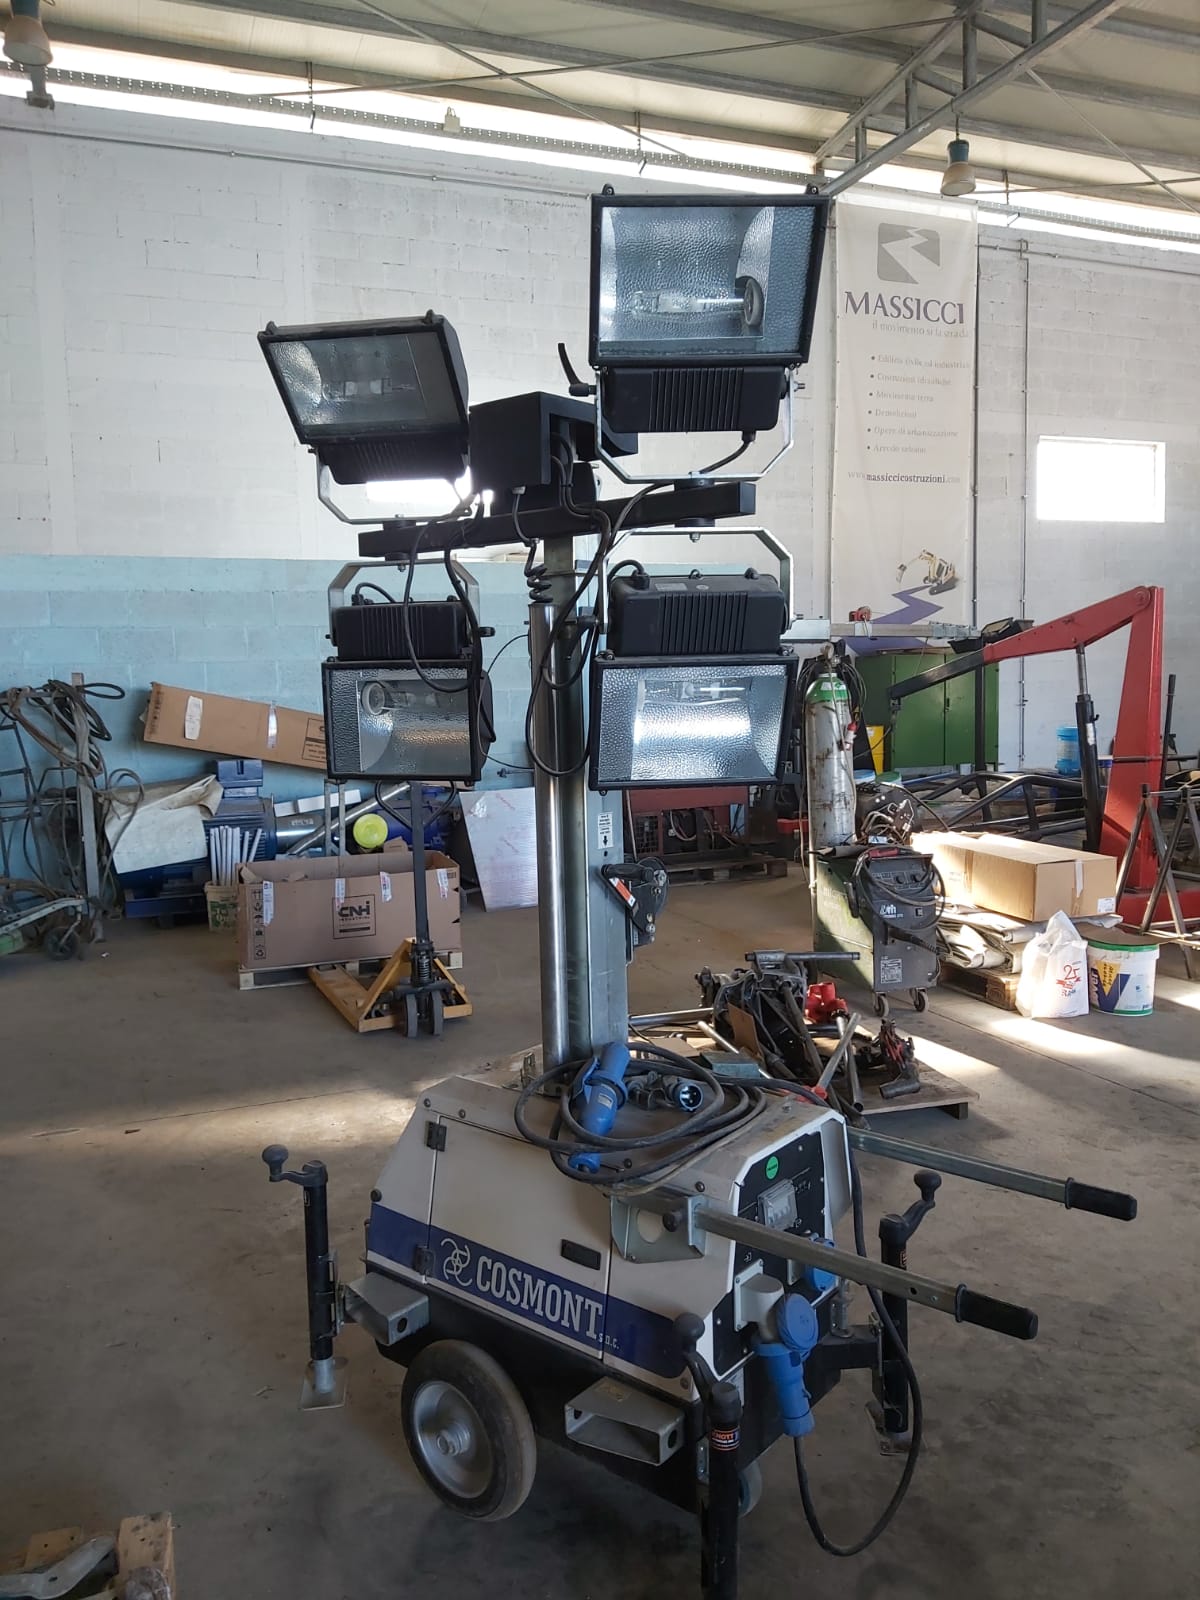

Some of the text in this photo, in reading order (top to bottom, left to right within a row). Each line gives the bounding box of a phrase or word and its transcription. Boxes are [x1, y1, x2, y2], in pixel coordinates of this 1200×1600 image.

[844, 291, 965, 325] MASSICCI
[338, 900, 370, 917] CNH
[476, 1255, 604, 1340] COSMONT
